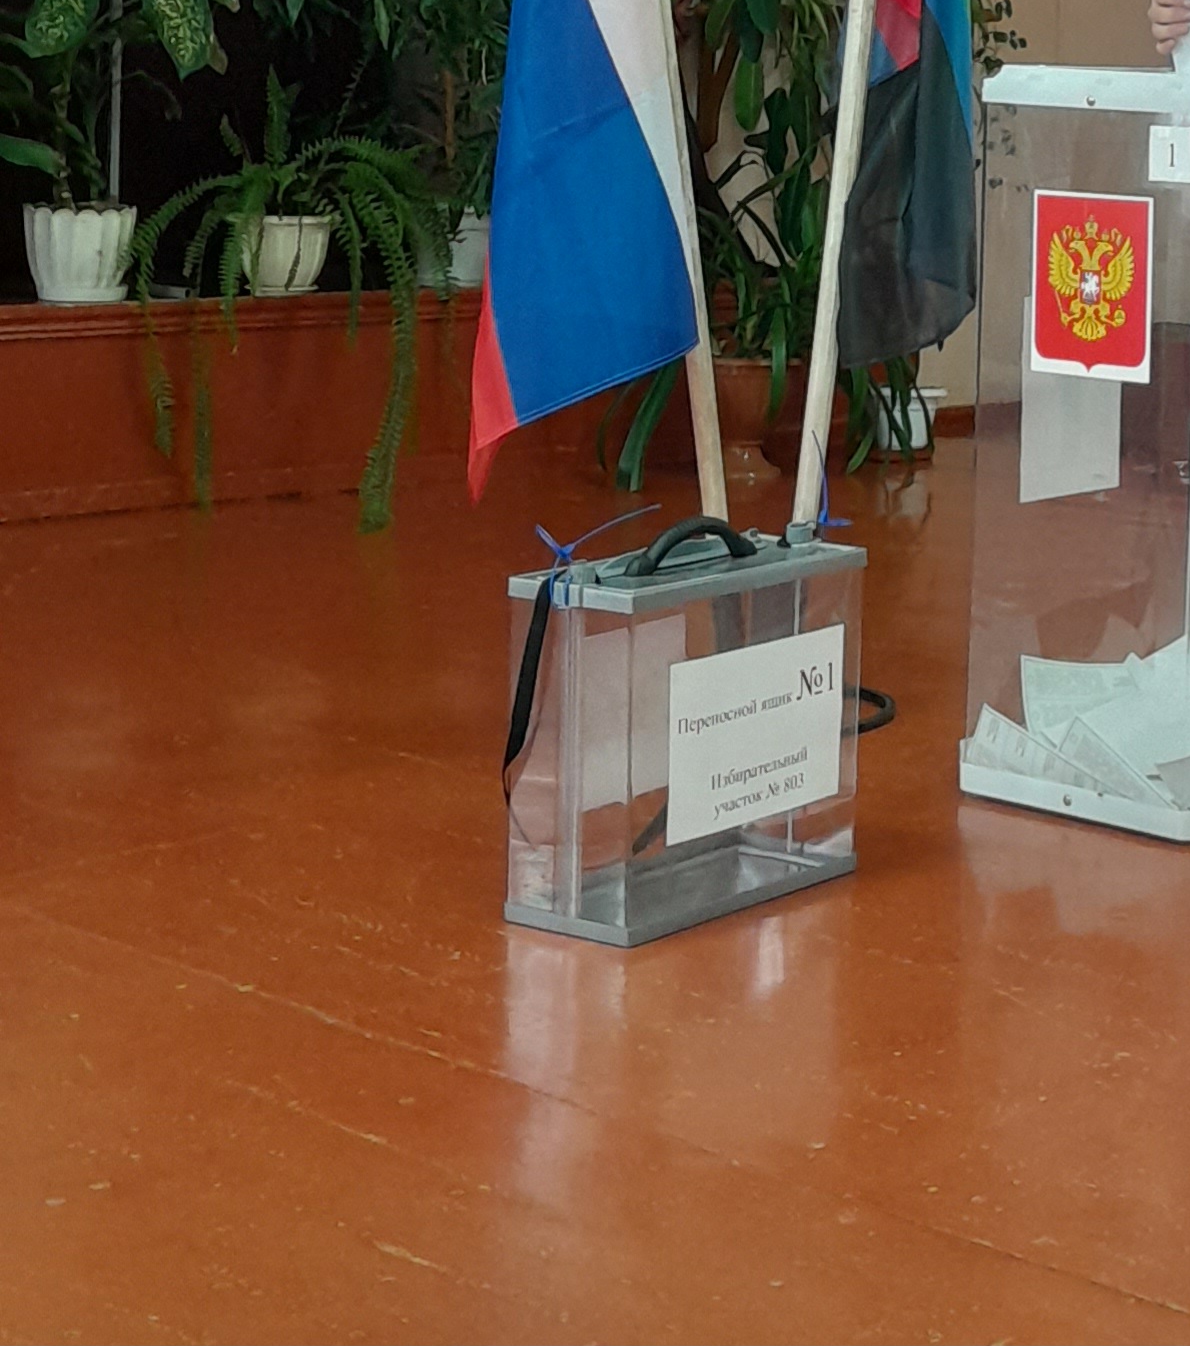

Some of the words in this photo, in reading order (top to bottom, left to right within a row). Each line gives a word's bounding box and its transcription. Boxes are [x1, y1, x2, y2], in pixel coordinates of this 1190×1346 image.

[1168, 142, 1175, 167] 1
[677, 698, 758, 735] Переносной
[760, 691, 793, 712] ящик
[711, 747, 808, 791] Избирательный
[713, 789, 764, 820] участок
[783, 772, 805, 793] 803
